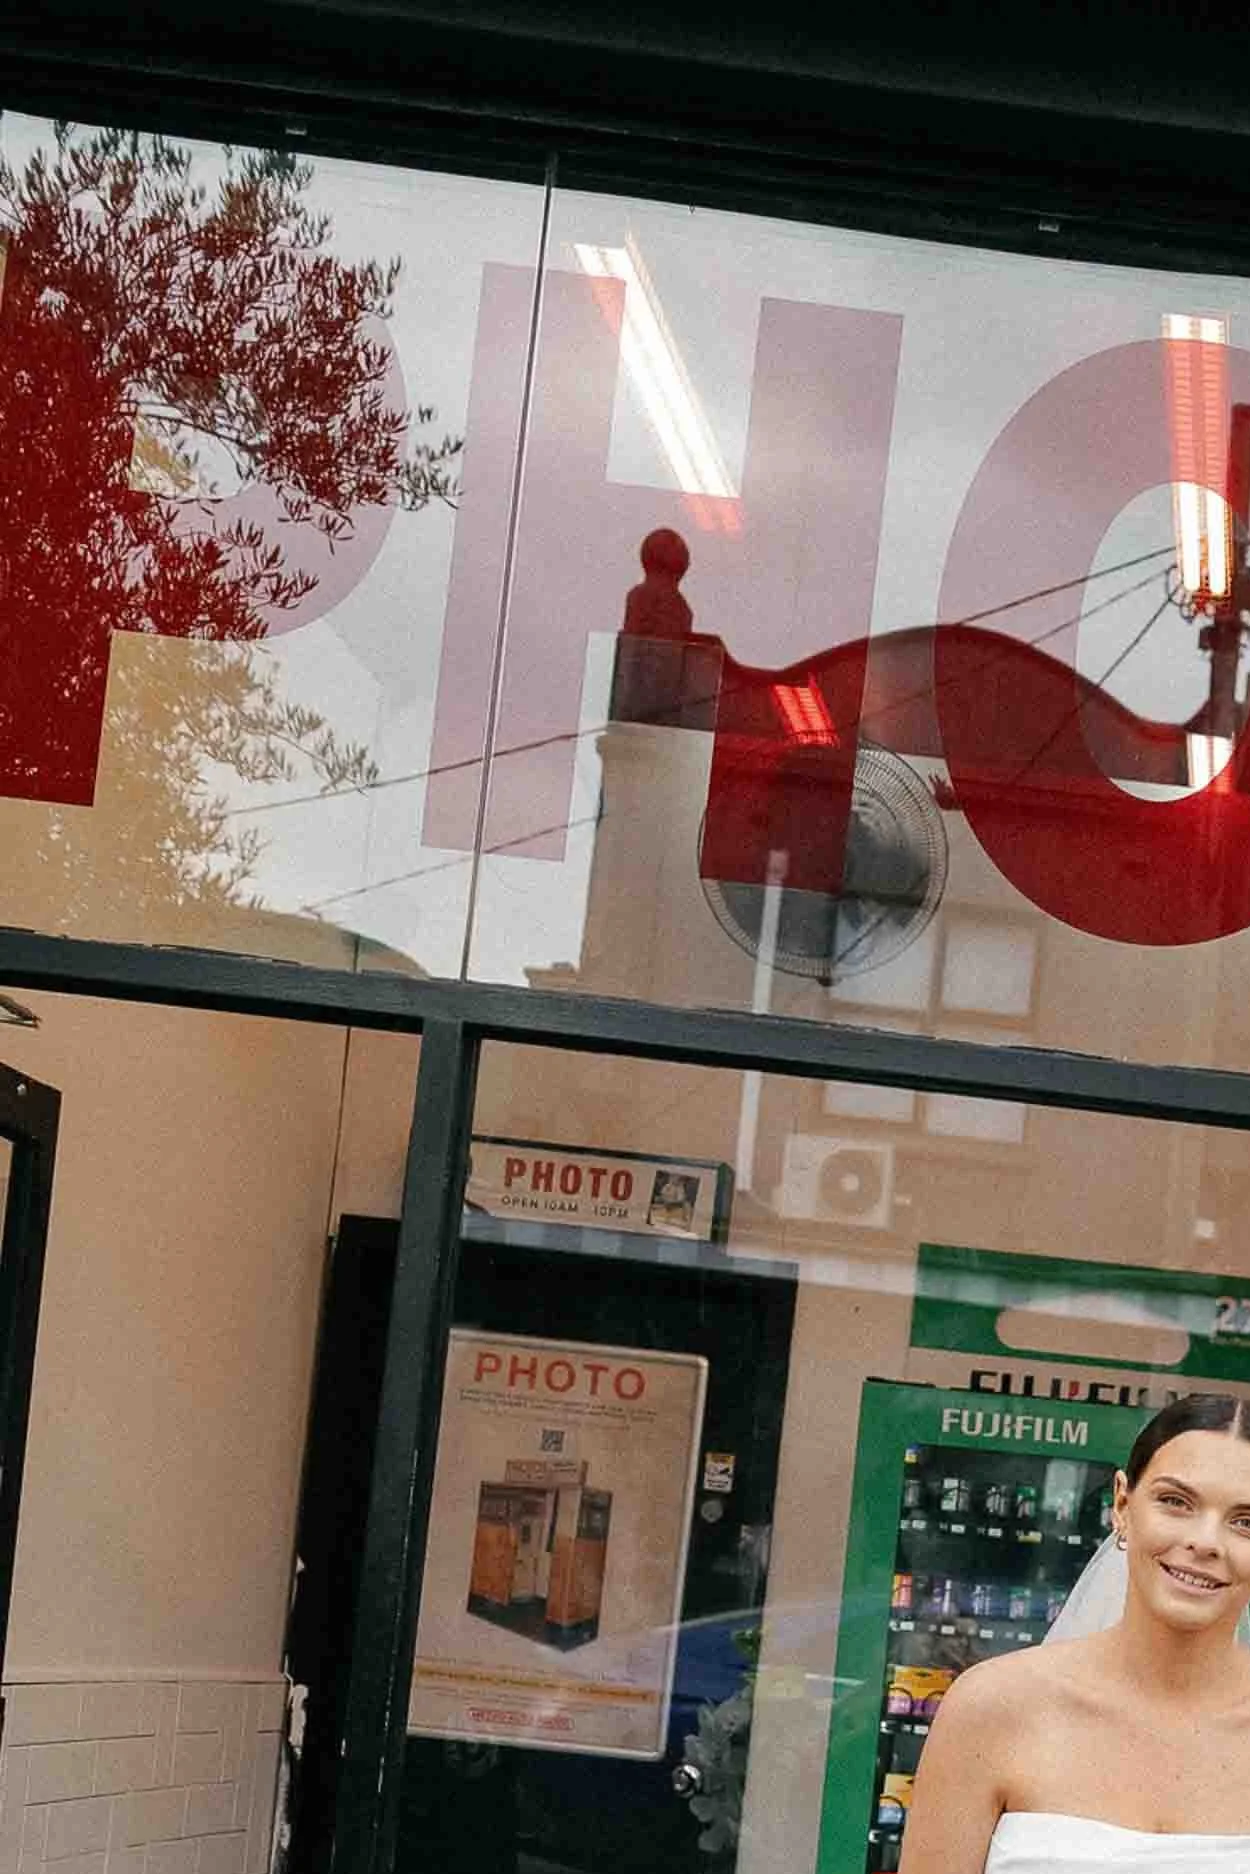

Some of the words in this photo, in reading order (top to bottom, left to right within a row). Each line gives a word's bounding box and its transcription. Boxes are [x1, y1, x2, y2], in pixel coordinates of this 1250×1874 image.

[503, 1156, 634, 1201] PHOTO
[501, 1195, 538, 1209] OPEN
[544, 1200, 579, 1212] 10AM
[473, 1352, 646, 1401] PHOTO
[941, 1407, 1089, 1447] FUJIFILM
